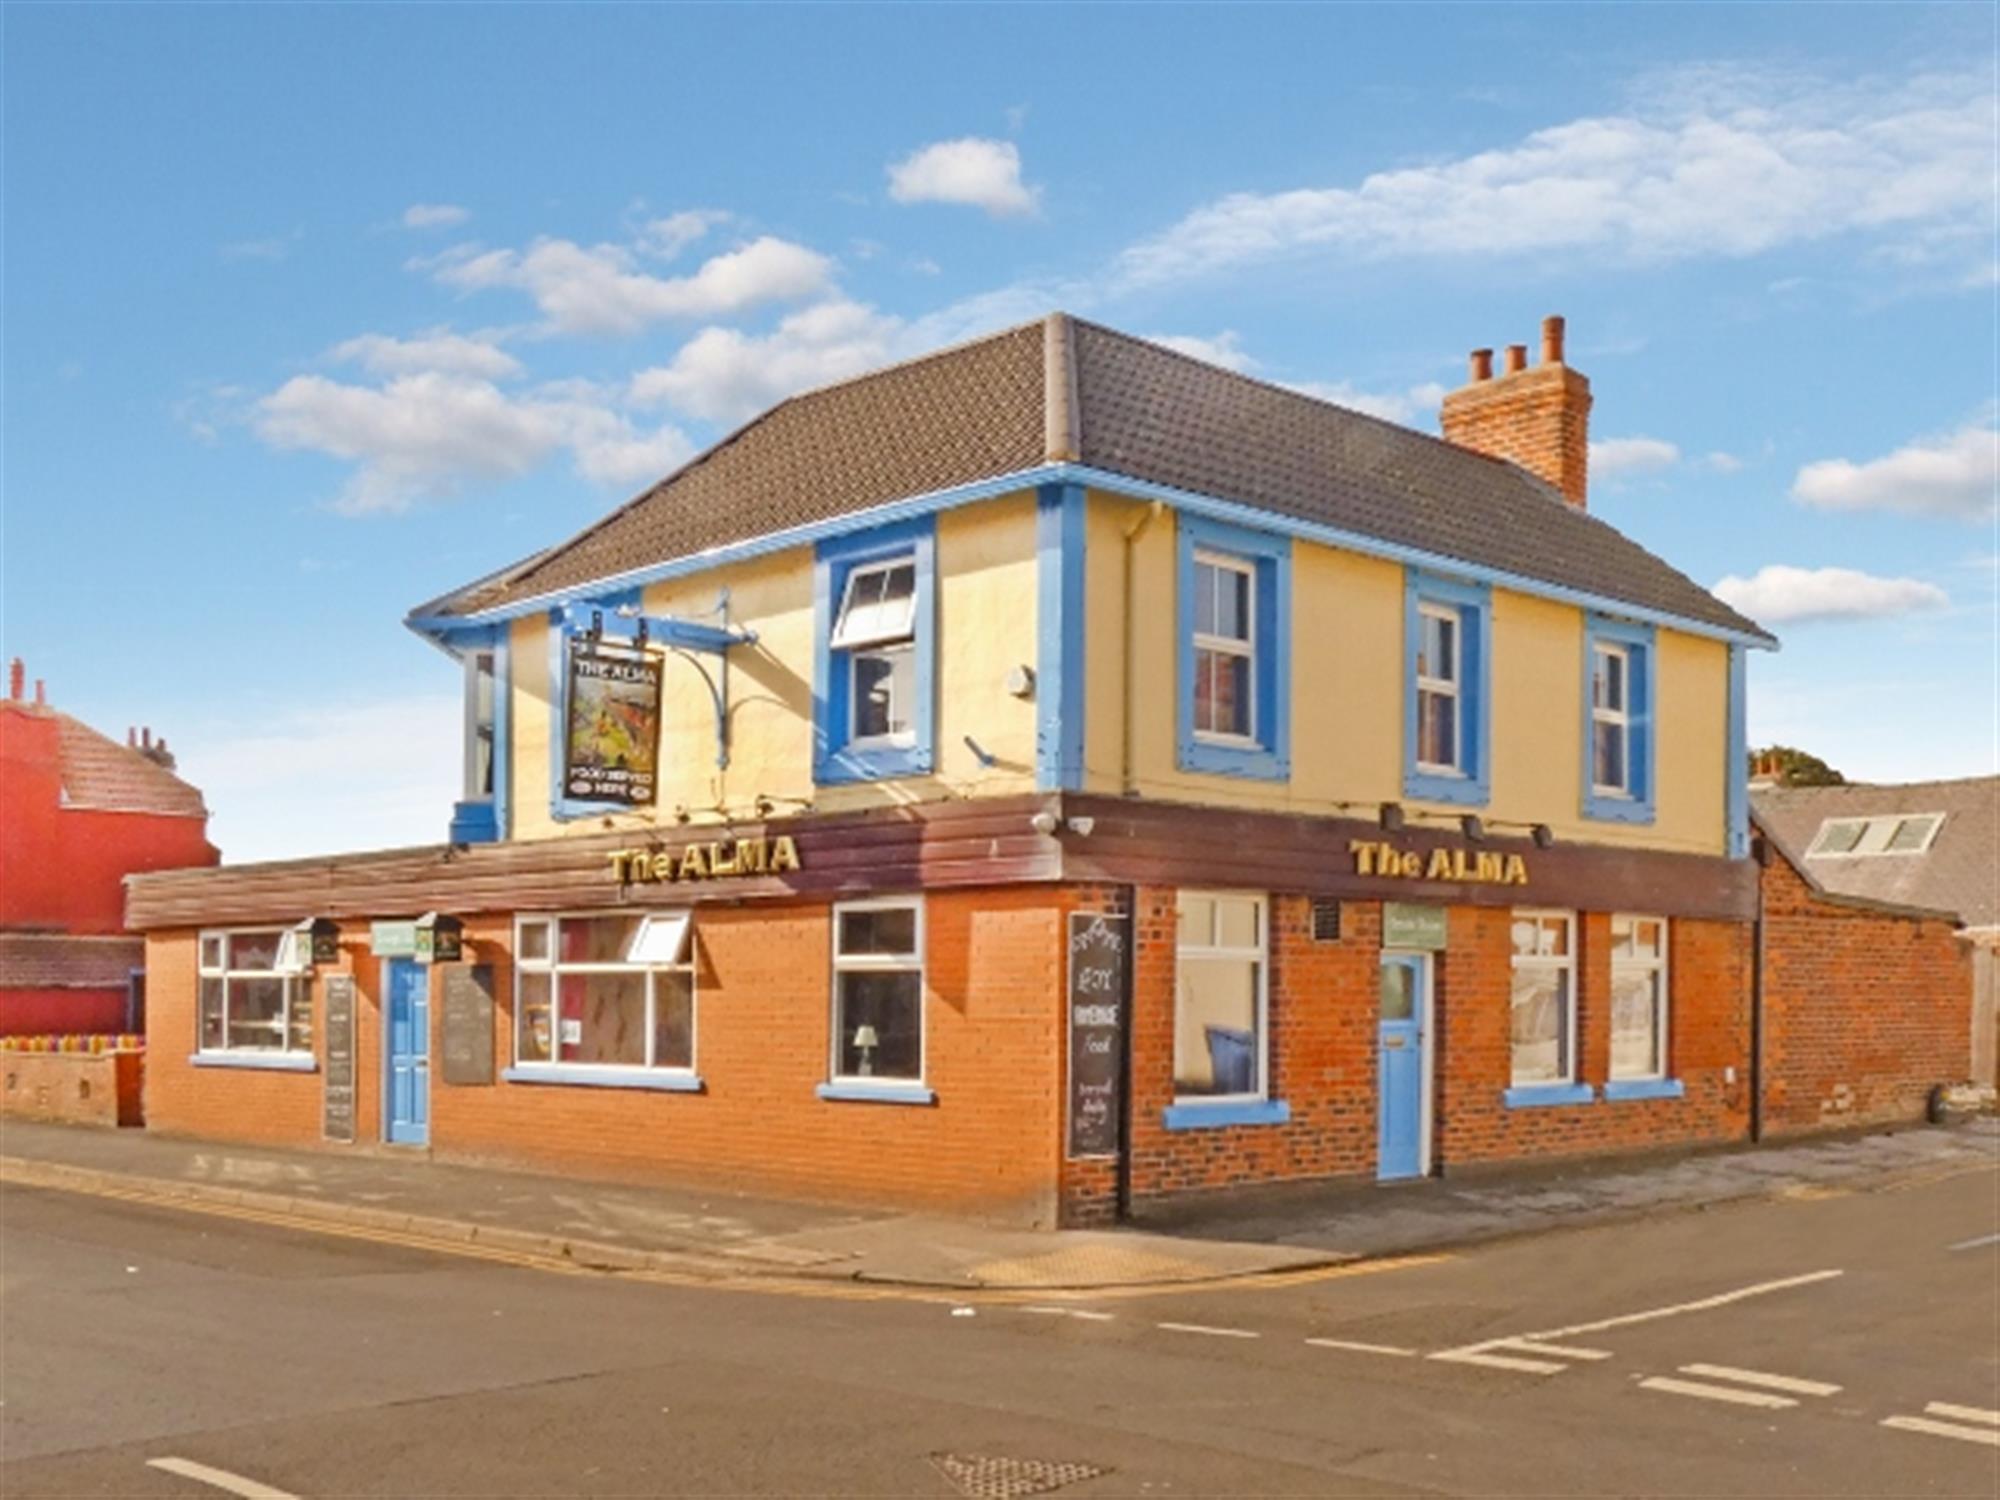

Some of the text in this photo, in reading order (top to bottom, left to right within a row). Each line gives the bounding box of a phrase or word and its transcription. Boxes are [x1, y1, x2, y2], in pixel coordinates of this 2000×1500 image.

[576, 659, 656, 685] THE ALMA
[607, 835, 800, 882] The ALMA
[1350, 839, 1529, 886] The ALMA
